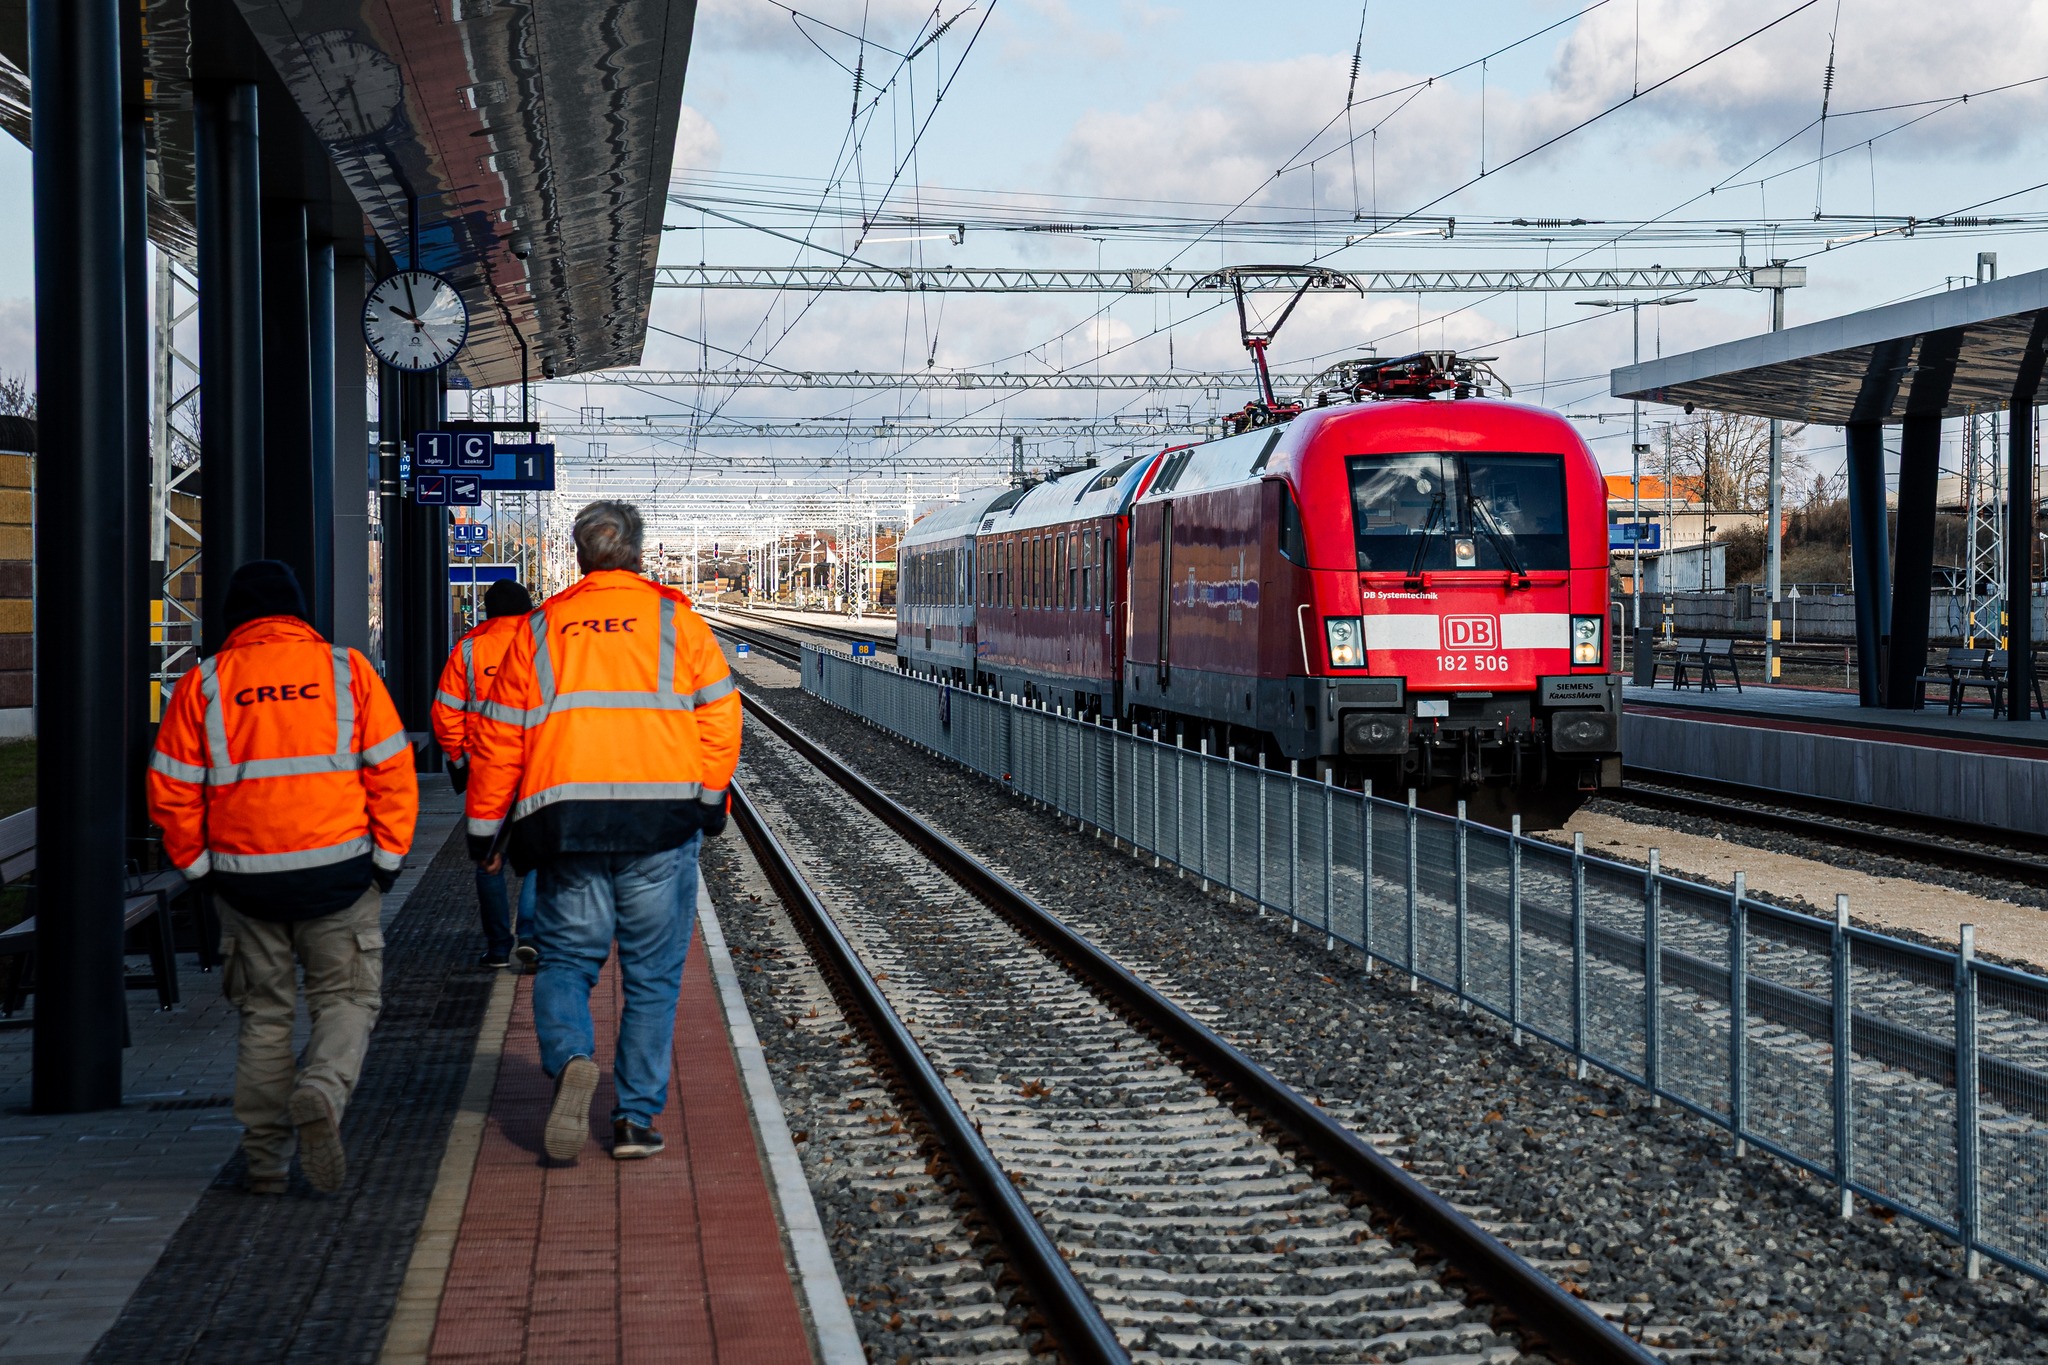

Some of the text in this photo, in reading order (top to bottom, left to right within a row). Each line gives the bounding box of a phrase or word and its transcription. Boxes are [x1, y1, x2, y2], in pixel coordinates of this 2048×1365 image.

[429, 437, 483, 457] 1 C
[524, 457, 533, 477] 1
[459, 527, 484, 536] 1 D
[1364, 591, 1439, 600] DB Systemtechnik
[560, 618, 638, 637] CREC
[1451, 621, 1490, 644] DB
[1436, 655, 1509, 672] 182 506
[234, 683, 321, 707] CREC
[1556, 683, 1594, 691] SIEMENS
